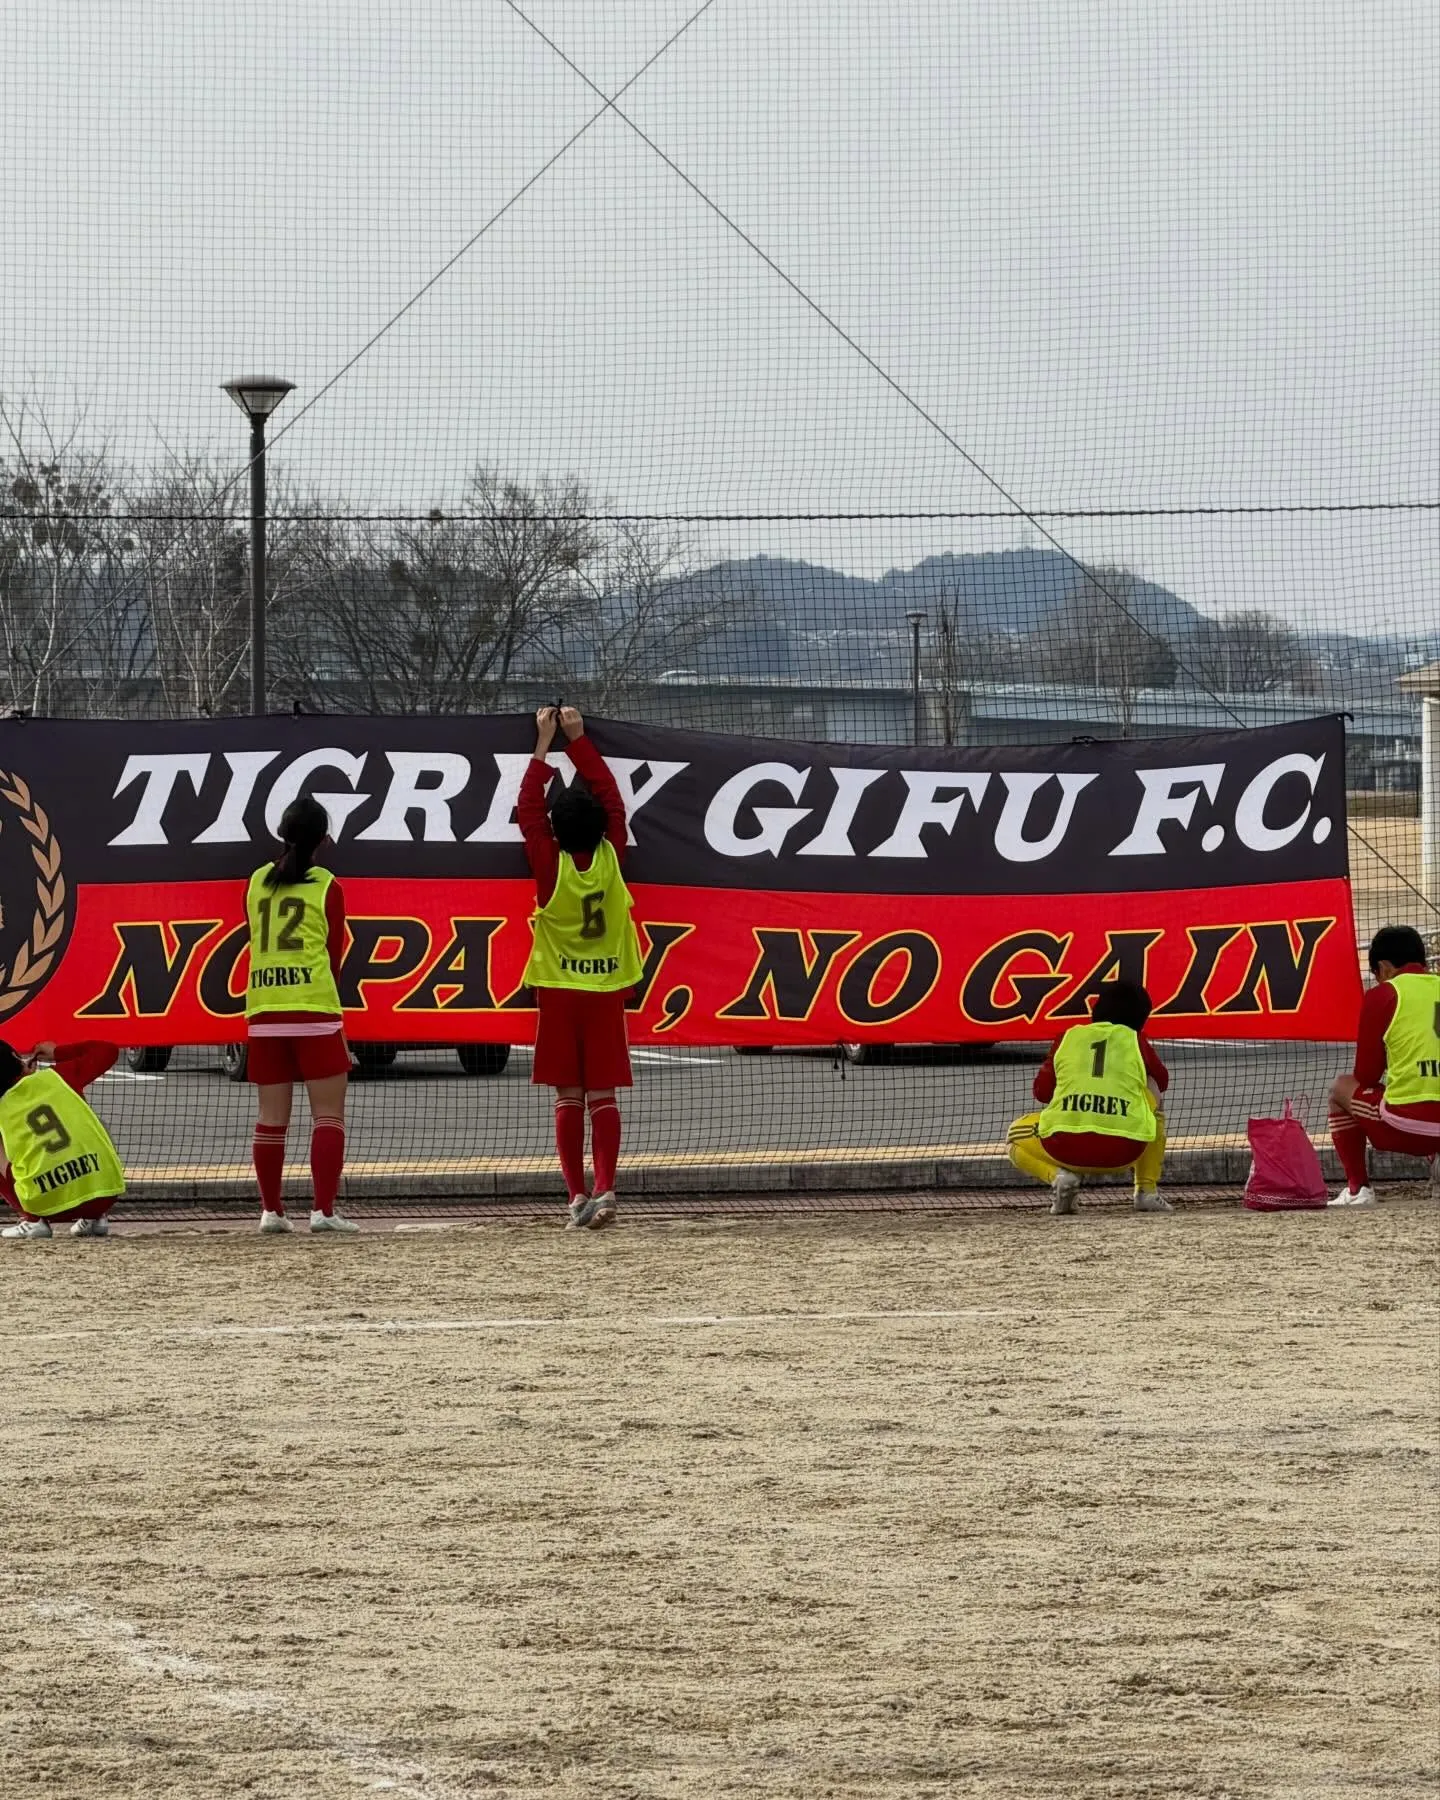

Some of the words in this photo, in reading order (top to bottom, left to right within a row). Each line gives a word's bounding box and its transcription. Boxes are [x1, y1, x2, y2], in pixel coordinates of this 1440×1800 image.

[107, 747, 690, 846] TIGREY
[703, 762, 1100, 862] GIFU
[1107, 752, 1332, 857] F.C.
[257, 896, 306, 953] 12
[251, 966, 313, 989] TIGREY
[339, 915, 696, 1033] PA,
[716, 927, 942, 1026] NO
[960, 917, 1336, 1025] GAIN
[1090, 1038, 1108, 1078] 1
[1061, 1093, 1131, 1117] TIGREY
[26, 1104, 71, 1154] 9
[33, 1152, 101, 1194] TIGREY
